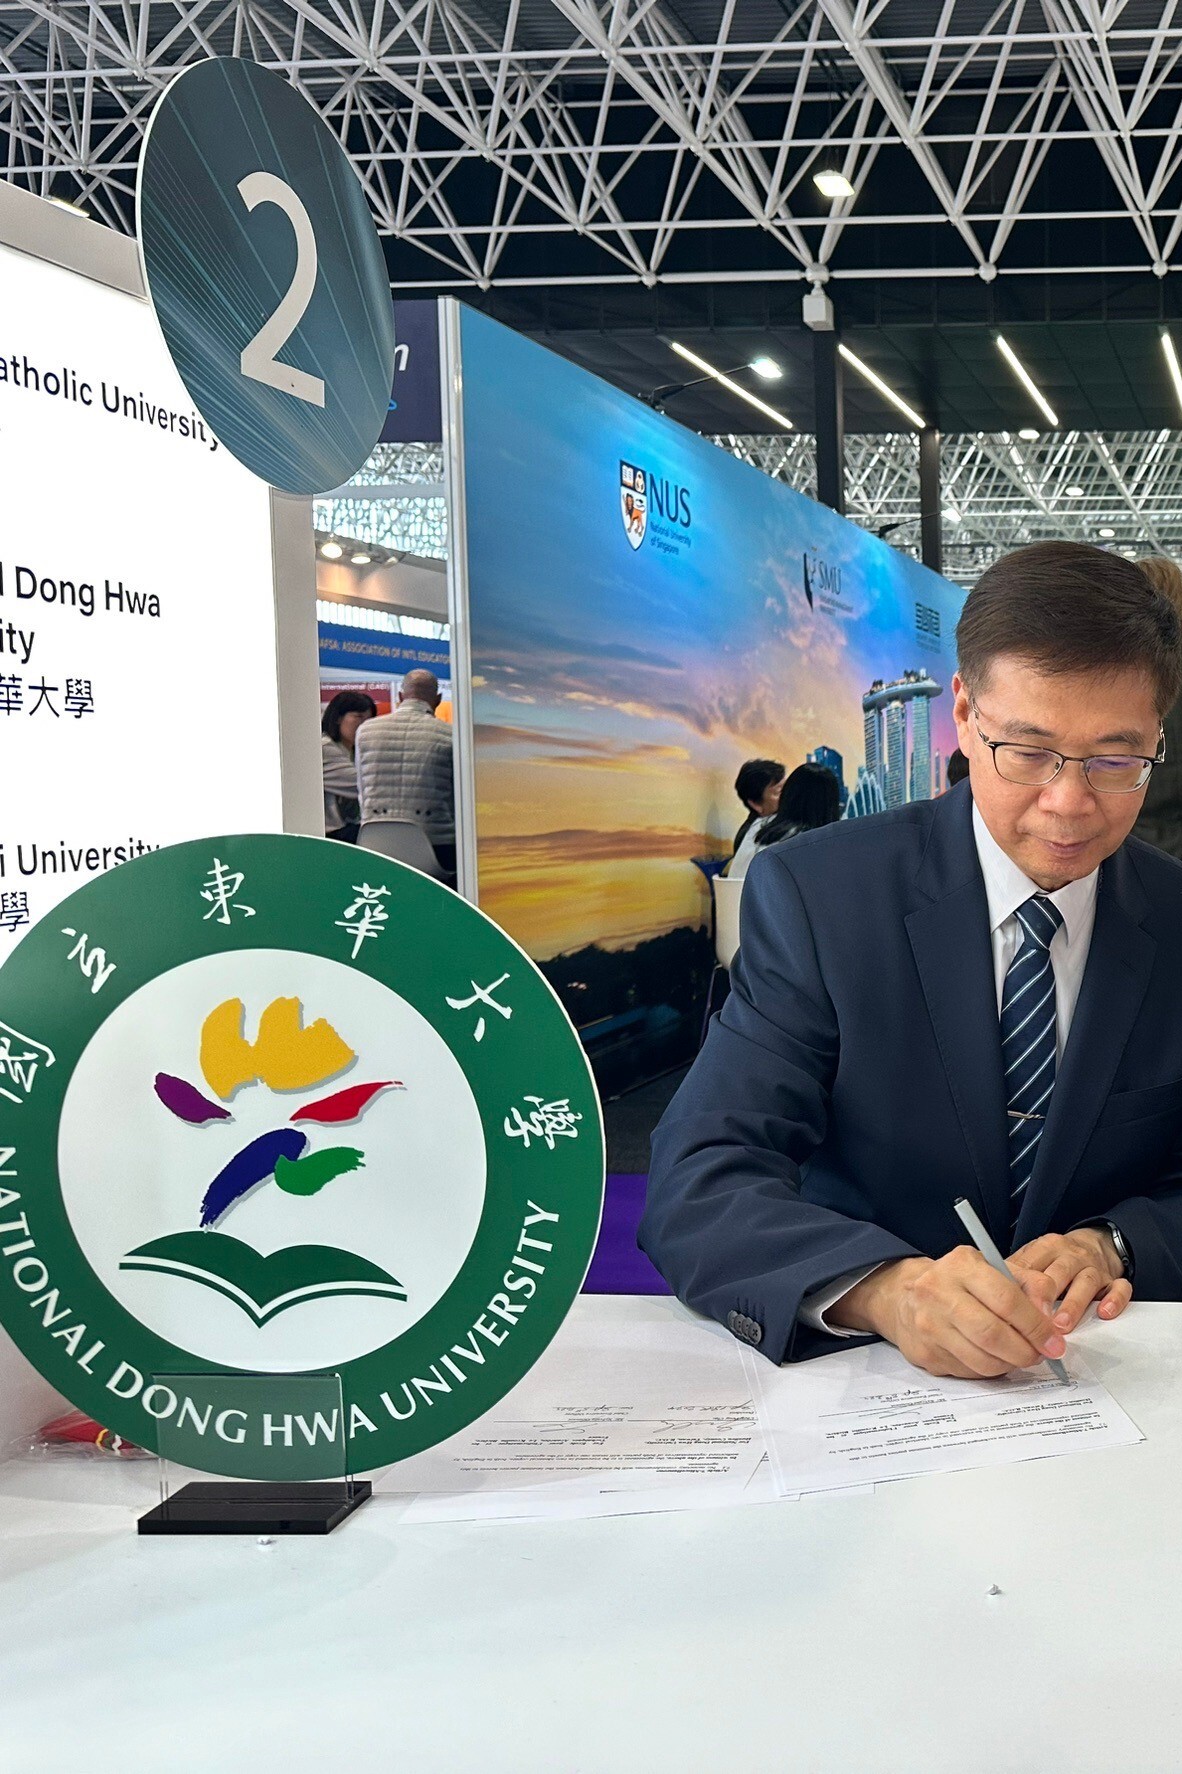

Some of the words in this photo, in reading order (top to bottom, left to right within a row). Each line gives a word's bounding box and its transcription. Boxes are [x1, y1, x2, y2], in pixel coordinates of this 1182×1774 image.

[237, 171, 325, 408] 2
[101, 382, 218, 451] Universit
[649, 473, 691, 528] NUS
[15, 566, 95, 617] Dong
[105, 579, 161, 618] Hwa
[818, 561, 842, 595] SMU
[342, 641, 391, 658] ASSOCIATION
[391, 648, 401, 658] OF
[17, 837, 160, 876] Universit
[106, 1361, 248, 1444] DONG
[262, 1404, 378, 1447] HWA
[379, 1199, 560, 1421] UNIVERSITY
